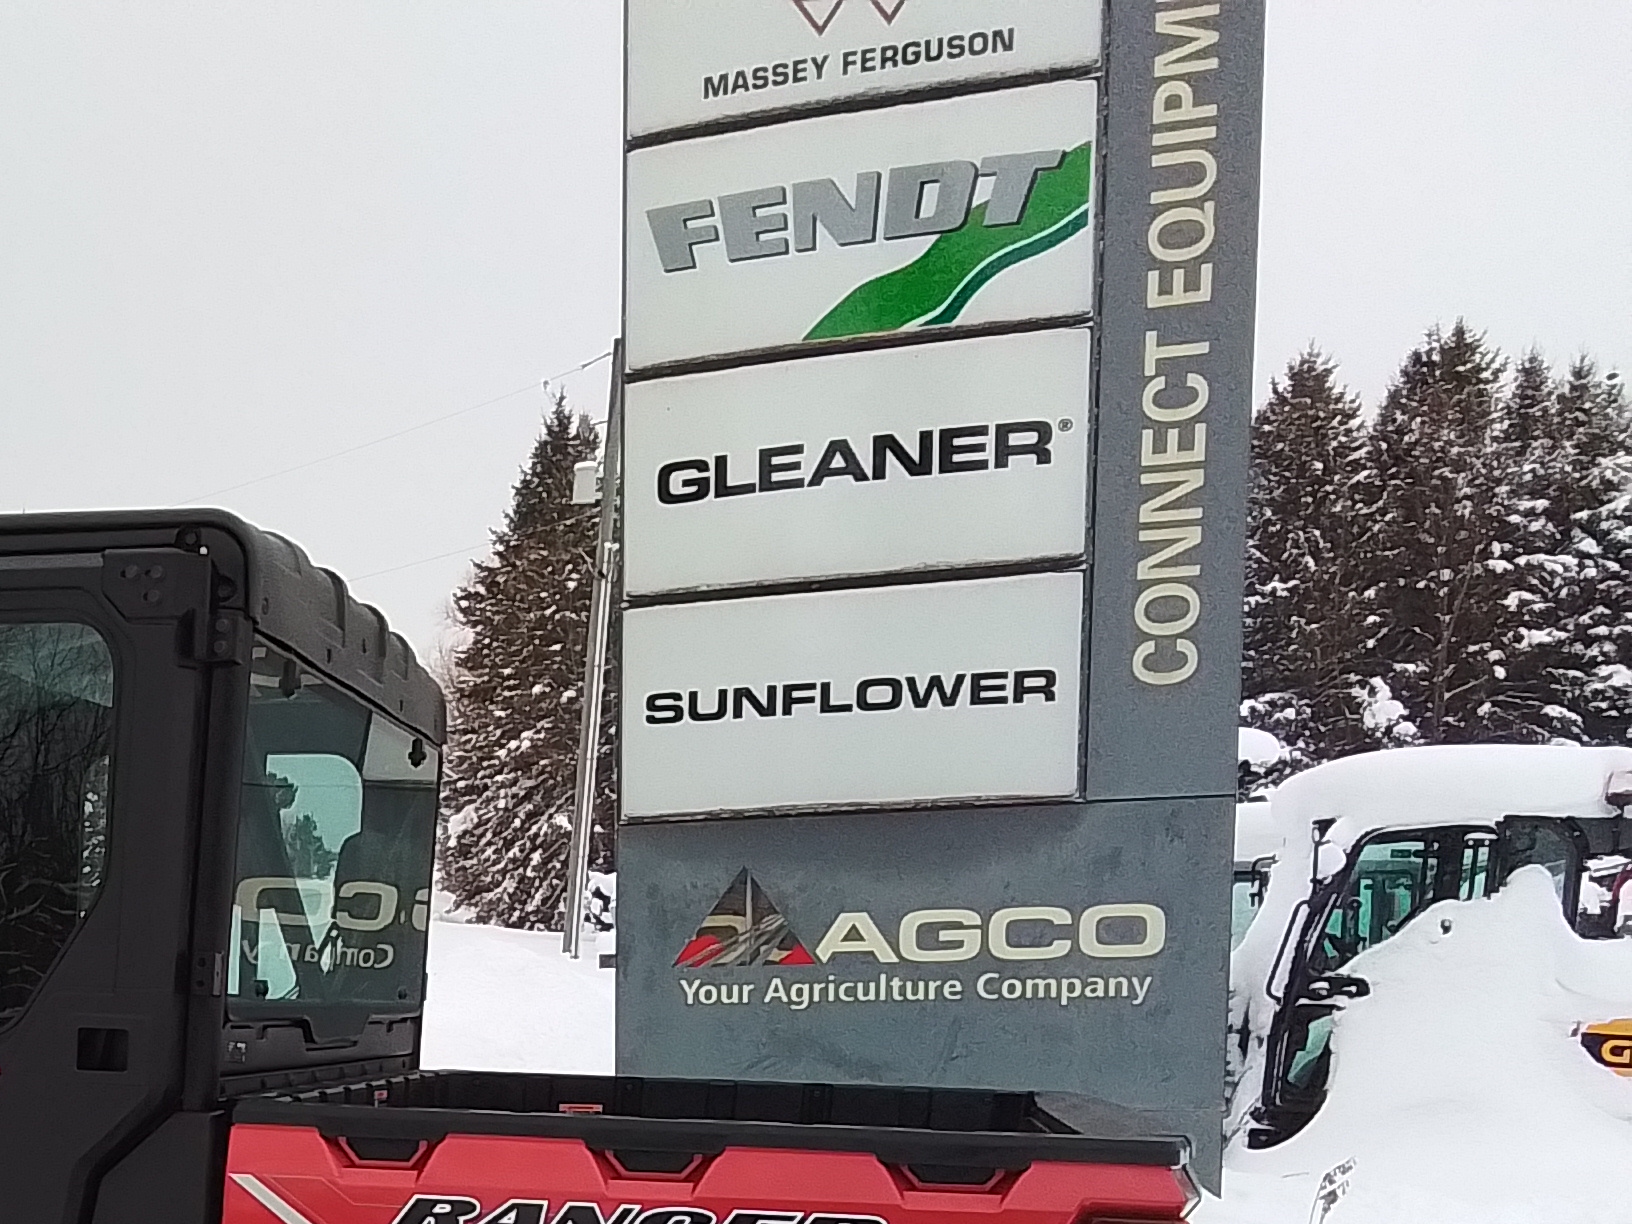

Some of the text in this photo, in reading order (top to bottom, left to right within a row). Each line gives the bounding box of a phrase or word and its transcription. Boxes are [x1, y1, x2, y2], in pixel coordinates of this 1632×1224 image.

[702, 27, 1016, 100] MASSEY FERGUSON
[645, 149, 1069, 273] FENDT
[1132, 0, 1221, 686] CONNECT EQUIPM
[645, 669, 1057, 725] SUNFLOWER
[815, 903, 1167, 964] AGCO
[680, 971, 1153, 1010] Your Agriculture Company
